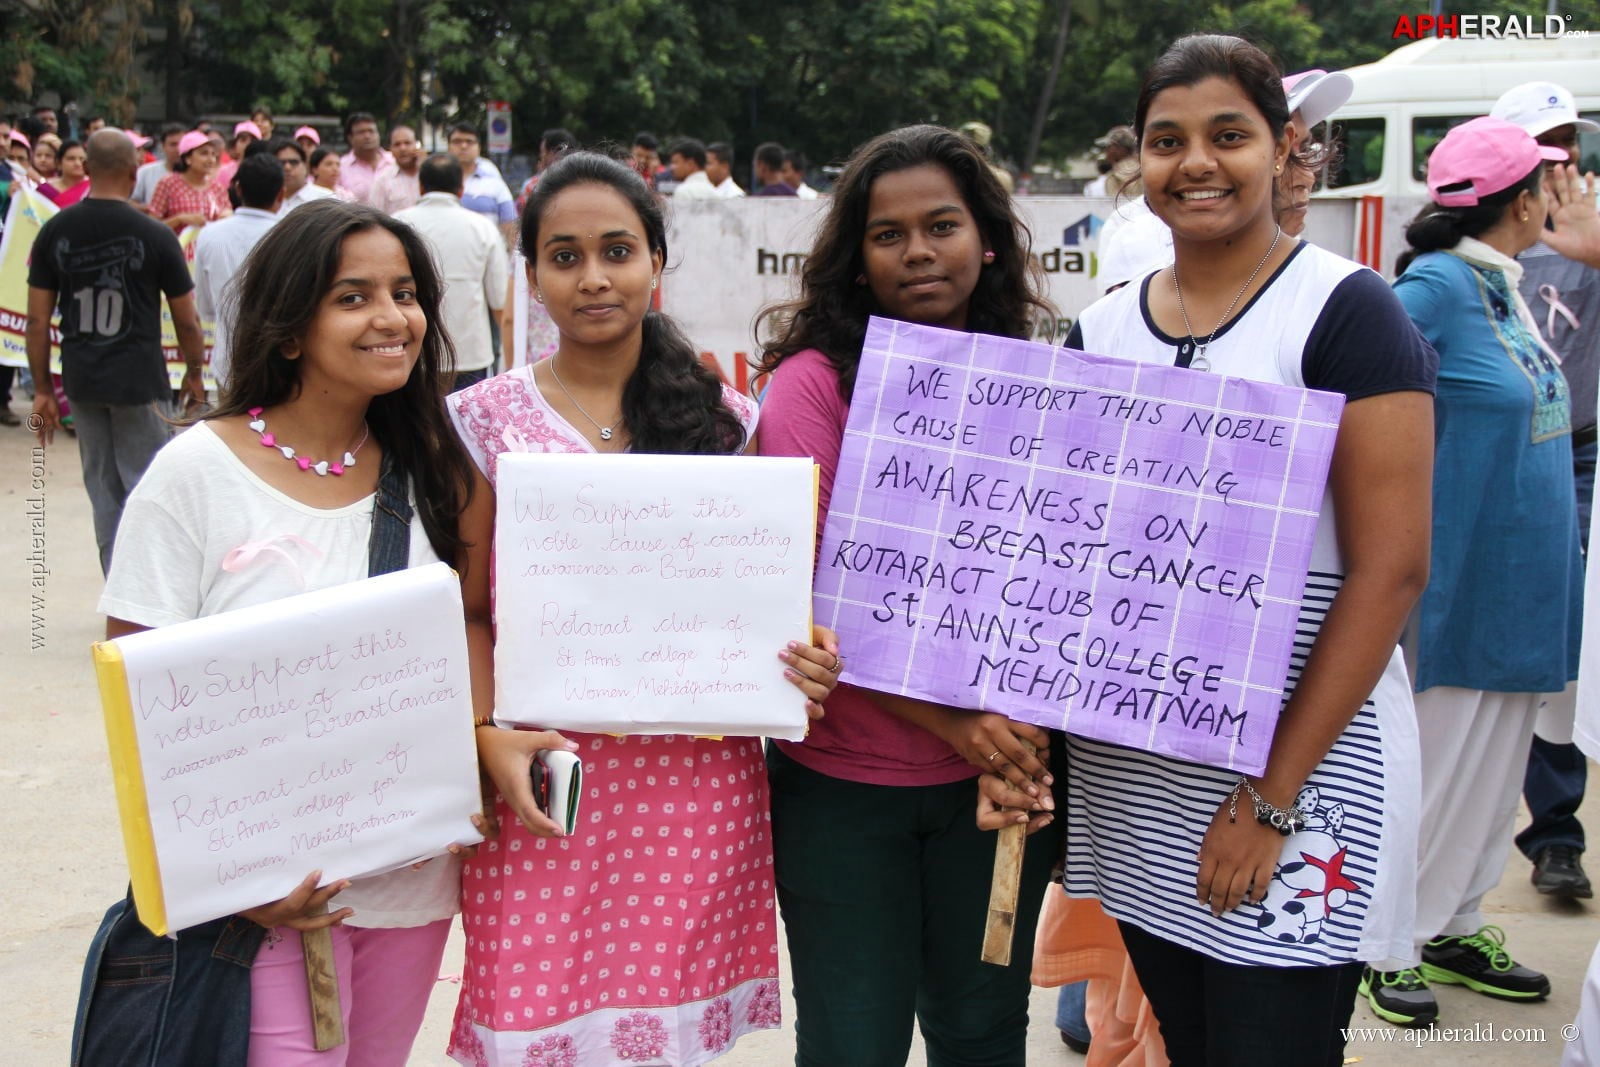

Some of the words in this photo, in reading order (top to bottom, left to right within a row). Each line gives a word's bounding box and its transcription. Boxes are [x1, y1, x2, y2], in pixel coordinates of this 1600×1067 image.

[74, 287, 124, 336] 10
[907, 365, 951, 400] WE
[968, 377, 1087, 414] SUPPORT
[1099, 395, 1166, 425] THIS
[1181, 412, 1287, 448] NOBLE
[893, 410, 978, 446] CAUSE
[1009, 434, 1045, 460] OF
[1066, 447, 1240, 505] CREATING
[514, 487, 561, 523] We
[572, 483, 674, 537] Support
[692, 497, 747, 519] this
[875, 455, 1110, 532] AWARENESS
[1145, 514, 1208, 548] ON
[520, 530, 583, 552] noble
[600, 536, 667, 553] cause
[672, 531, 698, 561] of
[704, 528, 792, 558] creating
[520, 563, 618, 577] awareness
[627, 564, 652, 576] on
[660, 553, 726, 580] Breast
[735, 558, 793, 577] Cancer
[831, 540, 995, 594] ROTARACT
[1000, 577, 1093, 617] CLUB
[1111, 598, 1165, 632] OF
[539, 602, 633, 639] Rotaract
[652, 612, 707, 634] club
[720, 614, 751, 643] of
[138, 669, 199, 720] We
[205, 644, 346, 698] Support
[351, 629, 407, 660] this
[637, 645, 698, 676] college
[716, 648, 749, 673] for
[1058, 631, 1224, 696] COLLEGE
[155, 711, 224, 750] noble
[228, 697, 300, 727] cause
[308, 687, 343, 714] of
[351, 656, 448, 692] creating
[968, 653, 1249, 747] MEHDIPATNAM
[161, 746, 249, 781] awareness
[259, 734, 286, 750] on
[171, 779, 294, 832] Rotaract
[298, 758, 356, 790] club
[376, 742, 413, 775] of
[292, 789, 356, 818] college
[369, 775, 400, 805] for
